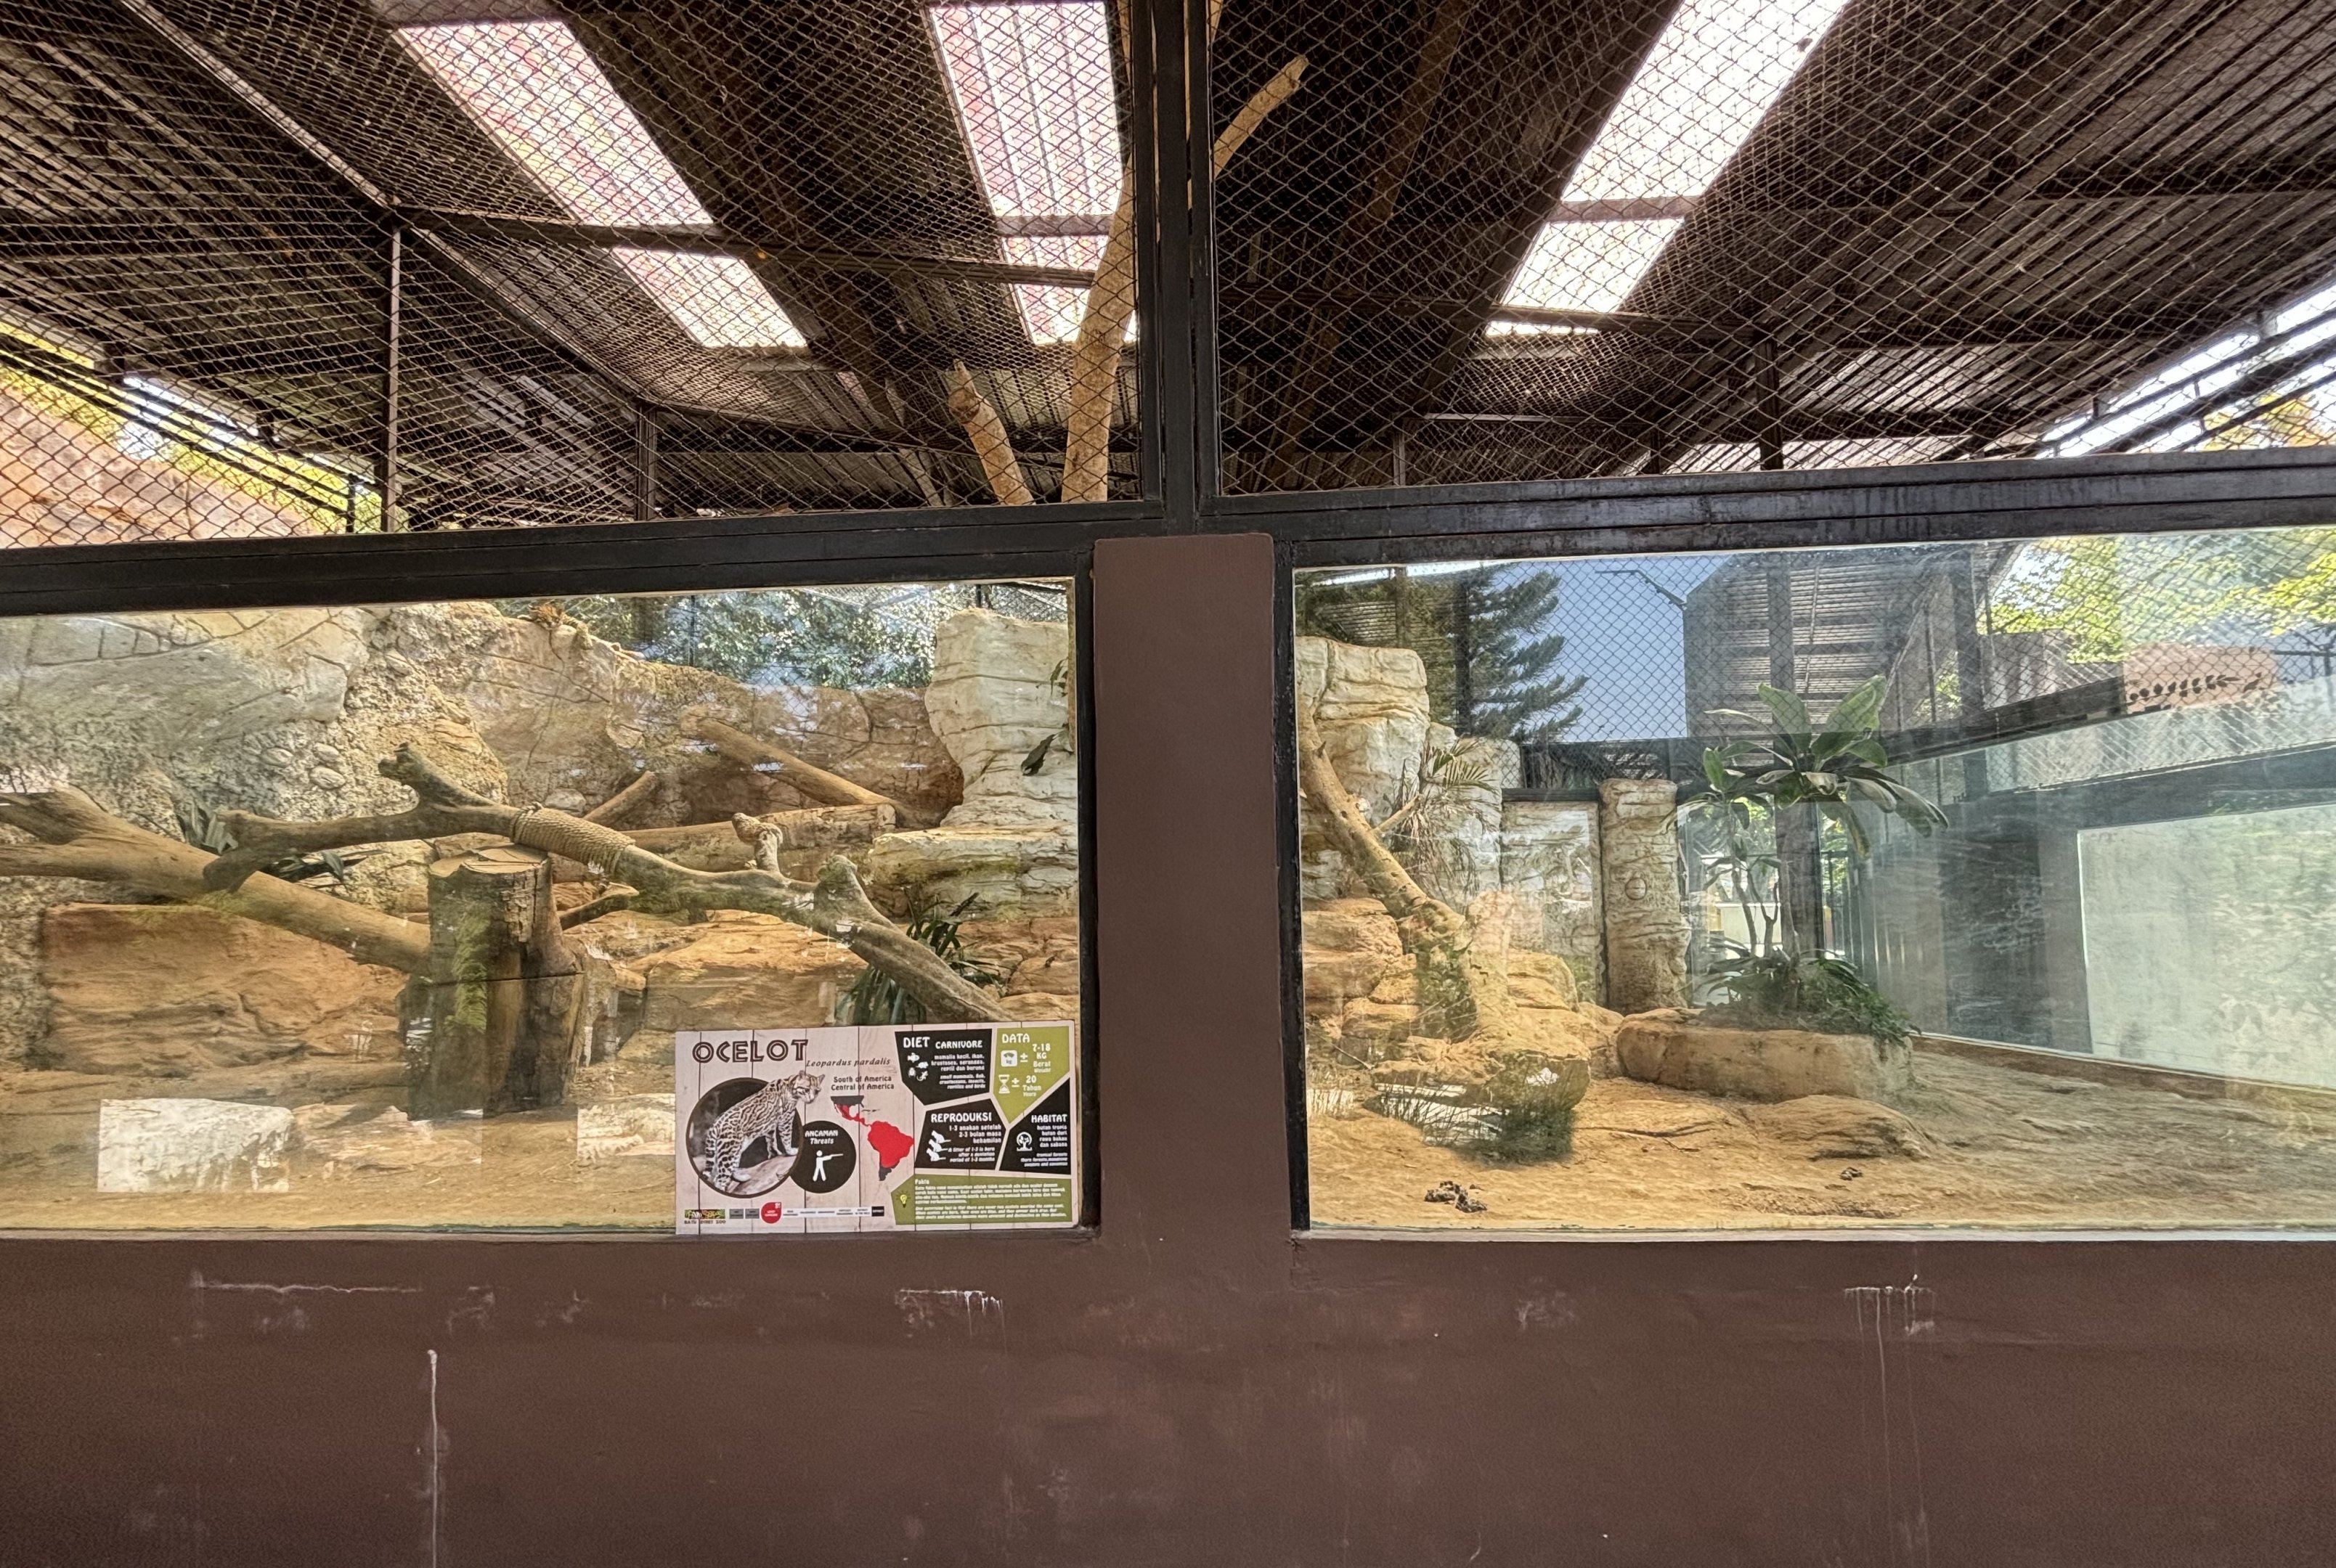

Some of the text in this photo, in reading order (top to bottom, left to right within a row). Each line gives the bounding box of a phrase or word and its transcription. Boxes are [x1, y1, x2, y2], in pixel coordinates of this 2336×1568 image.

[903, 1037, 983, 1049] DIET CARNIVORE
[1001, 1033, 1030, 1044] DATA
[692, 1039, 809, 1063] OCELOT
[1032, 1043, 1051, 1052] 7-18
[806, 1058, 891, 1068] Leopardus pardalis
[1025, 1075, 1037, 1084] 20
[931, 1112, 992, 1123] REPRODUKSI
[1031, 1114, 1067, 1123] HABITAT
